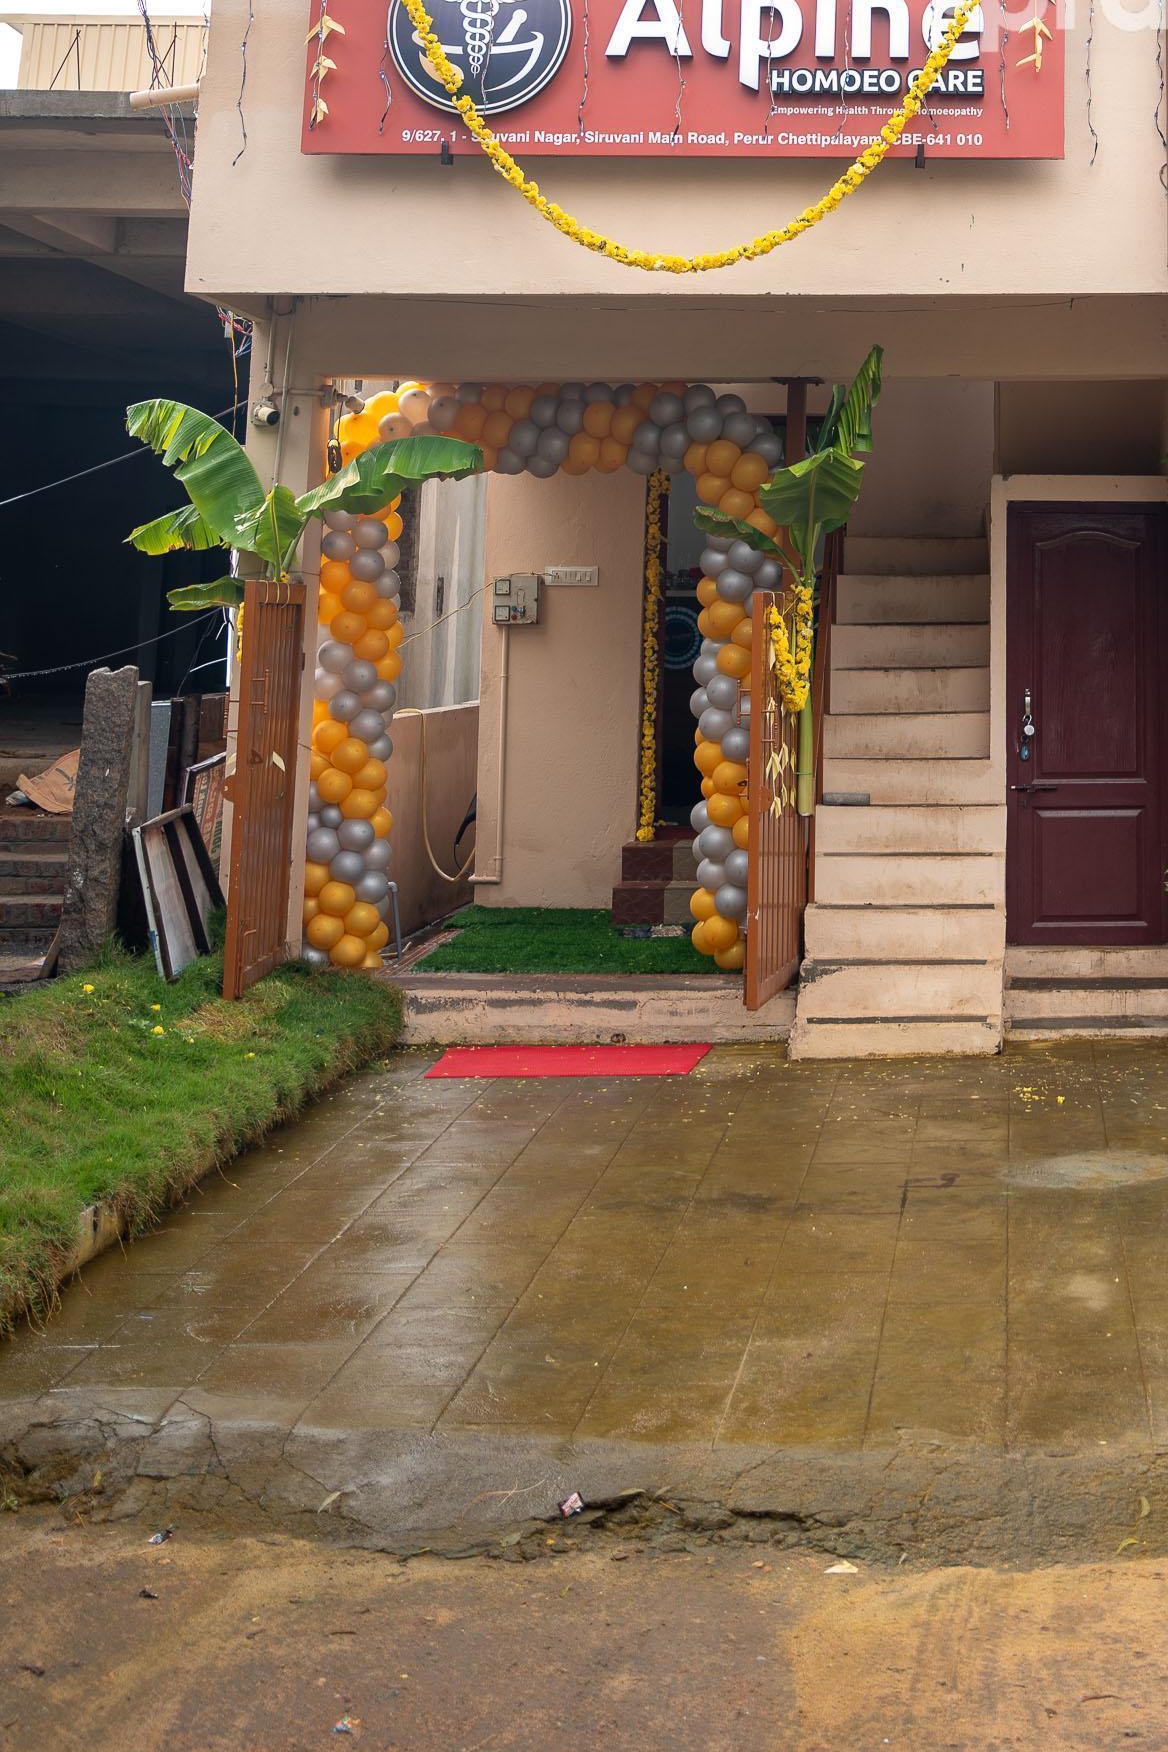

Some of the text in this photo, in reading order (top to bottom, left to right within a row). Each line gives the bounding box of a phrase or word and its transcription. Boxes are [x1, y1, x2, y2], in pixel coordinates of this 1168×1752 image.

[771, 69, 901, 93] HOMOEO
[771, 105, 834, 117] Empowering
[835, 105, 869, 116] Health
[870, 105, 908, 116] Throu
[471, 130, 530, 143] Suvani
[534, 130, 580, 145] Nagar,
[585, 130, 644, 144] Siruvani
[648, 131, 683, 144] Main
[688, 132, 729, 146] Road,
[734, 133, 773, 145] Perur
[956, 133, 983, 146] 010
